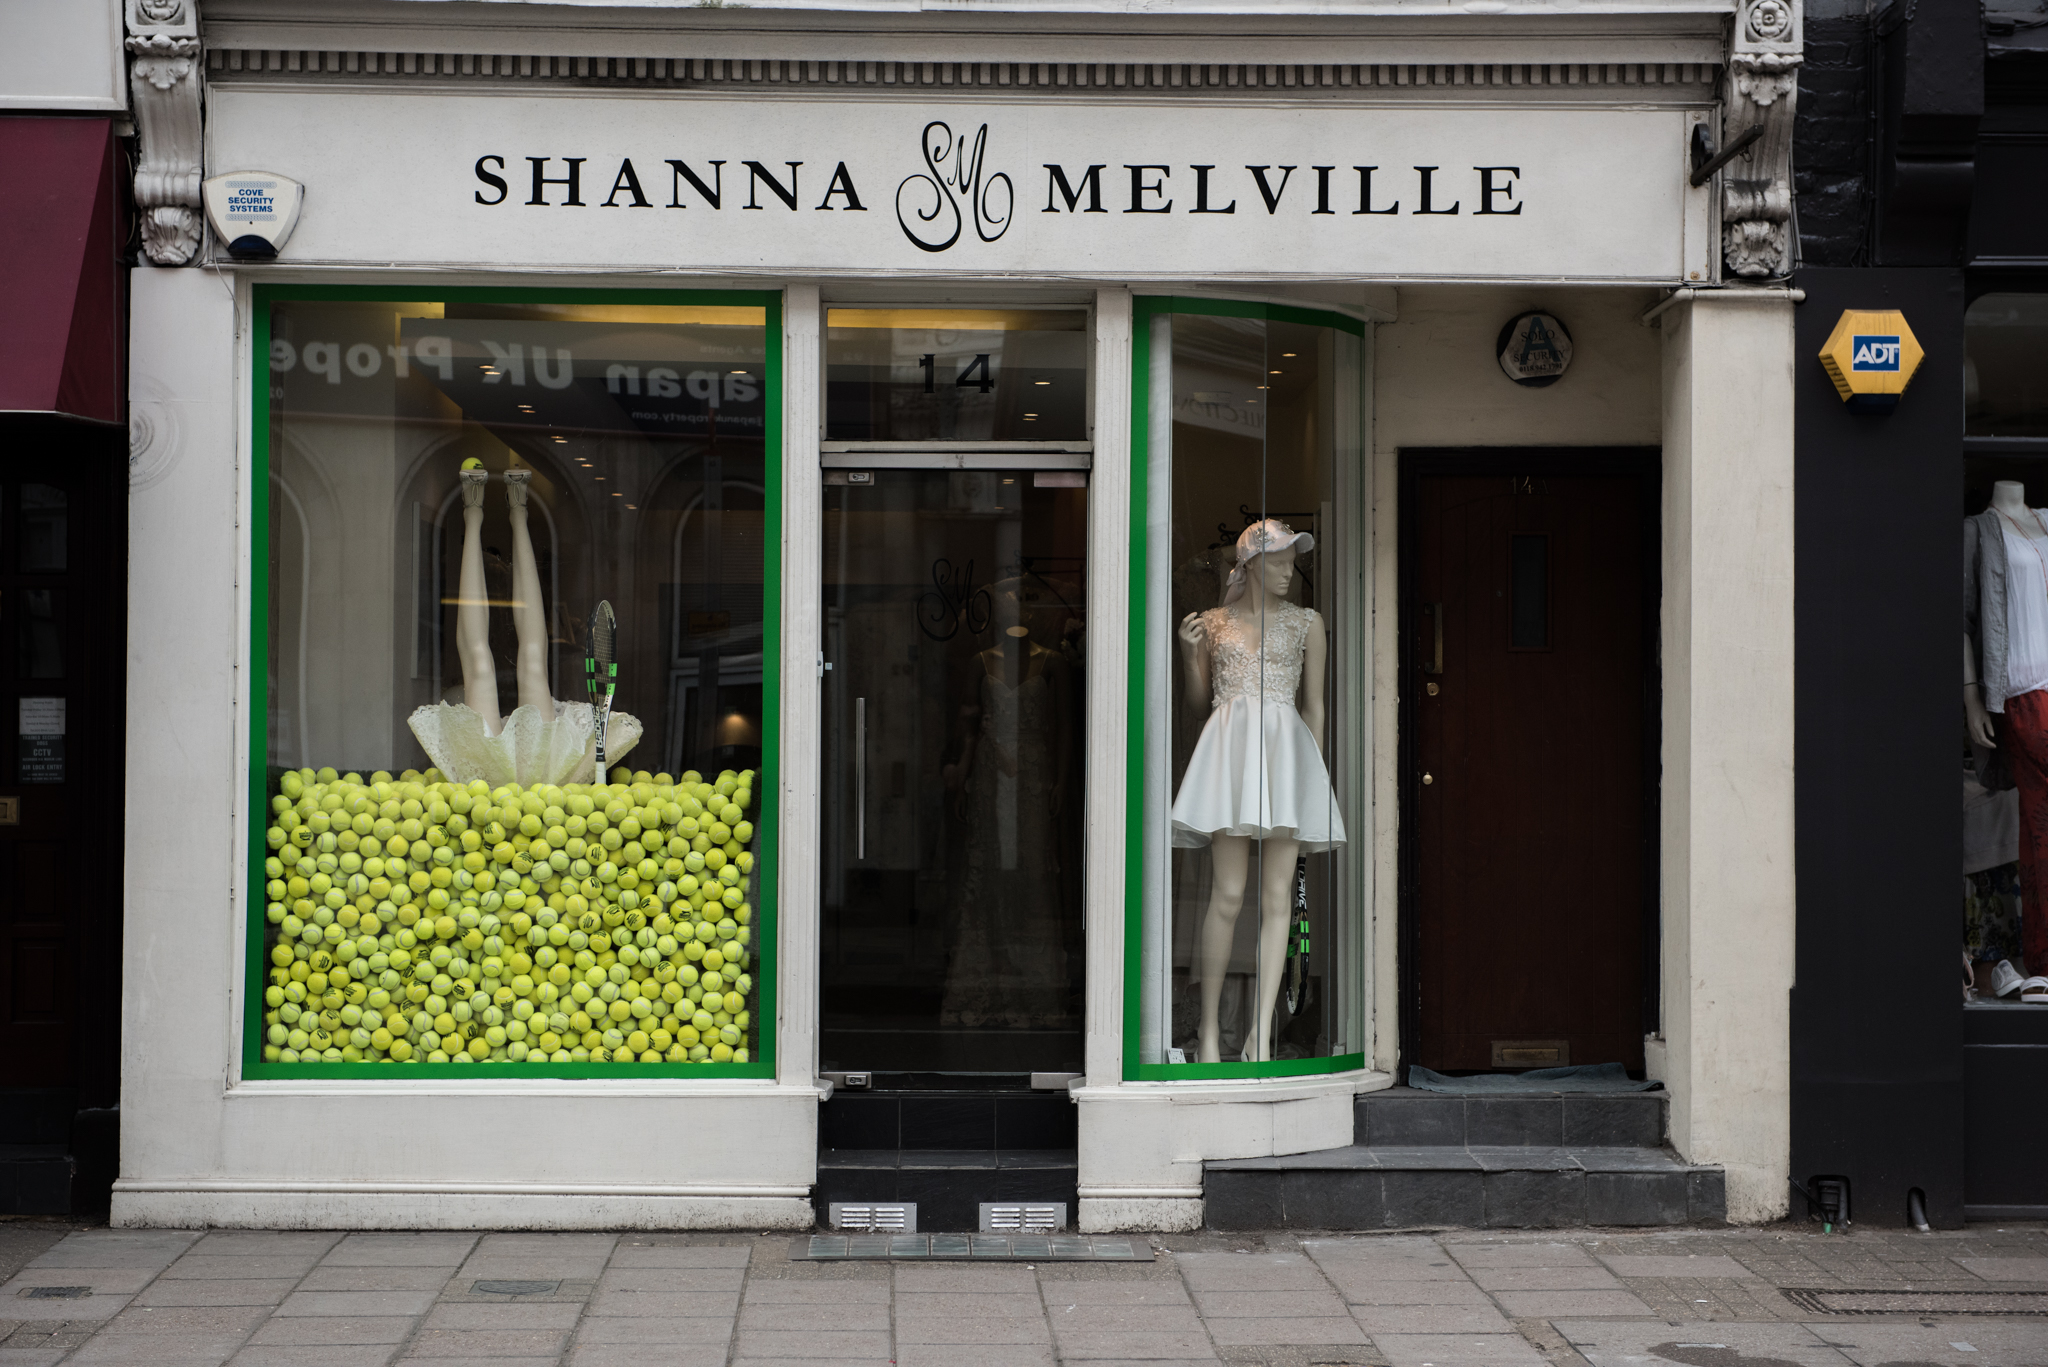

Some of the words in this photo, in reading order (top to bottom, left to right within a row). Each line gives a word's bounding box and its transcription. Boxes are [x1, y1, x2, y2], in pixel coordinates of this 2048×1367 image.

[474, 155, 868, 211] SHANNA
[1041, 163, 1524, 215] MELVILLE
[229, 205, 273, 213] SYSTEMS
[1521, 329, 1555, 342] SOLO
[1513, 350, 1565, 362] SECURITY
[1852, 342, 1900, 364] ADT
[919, 354, 995, 393] 14
[33, 748, 51, 757] CCTV
